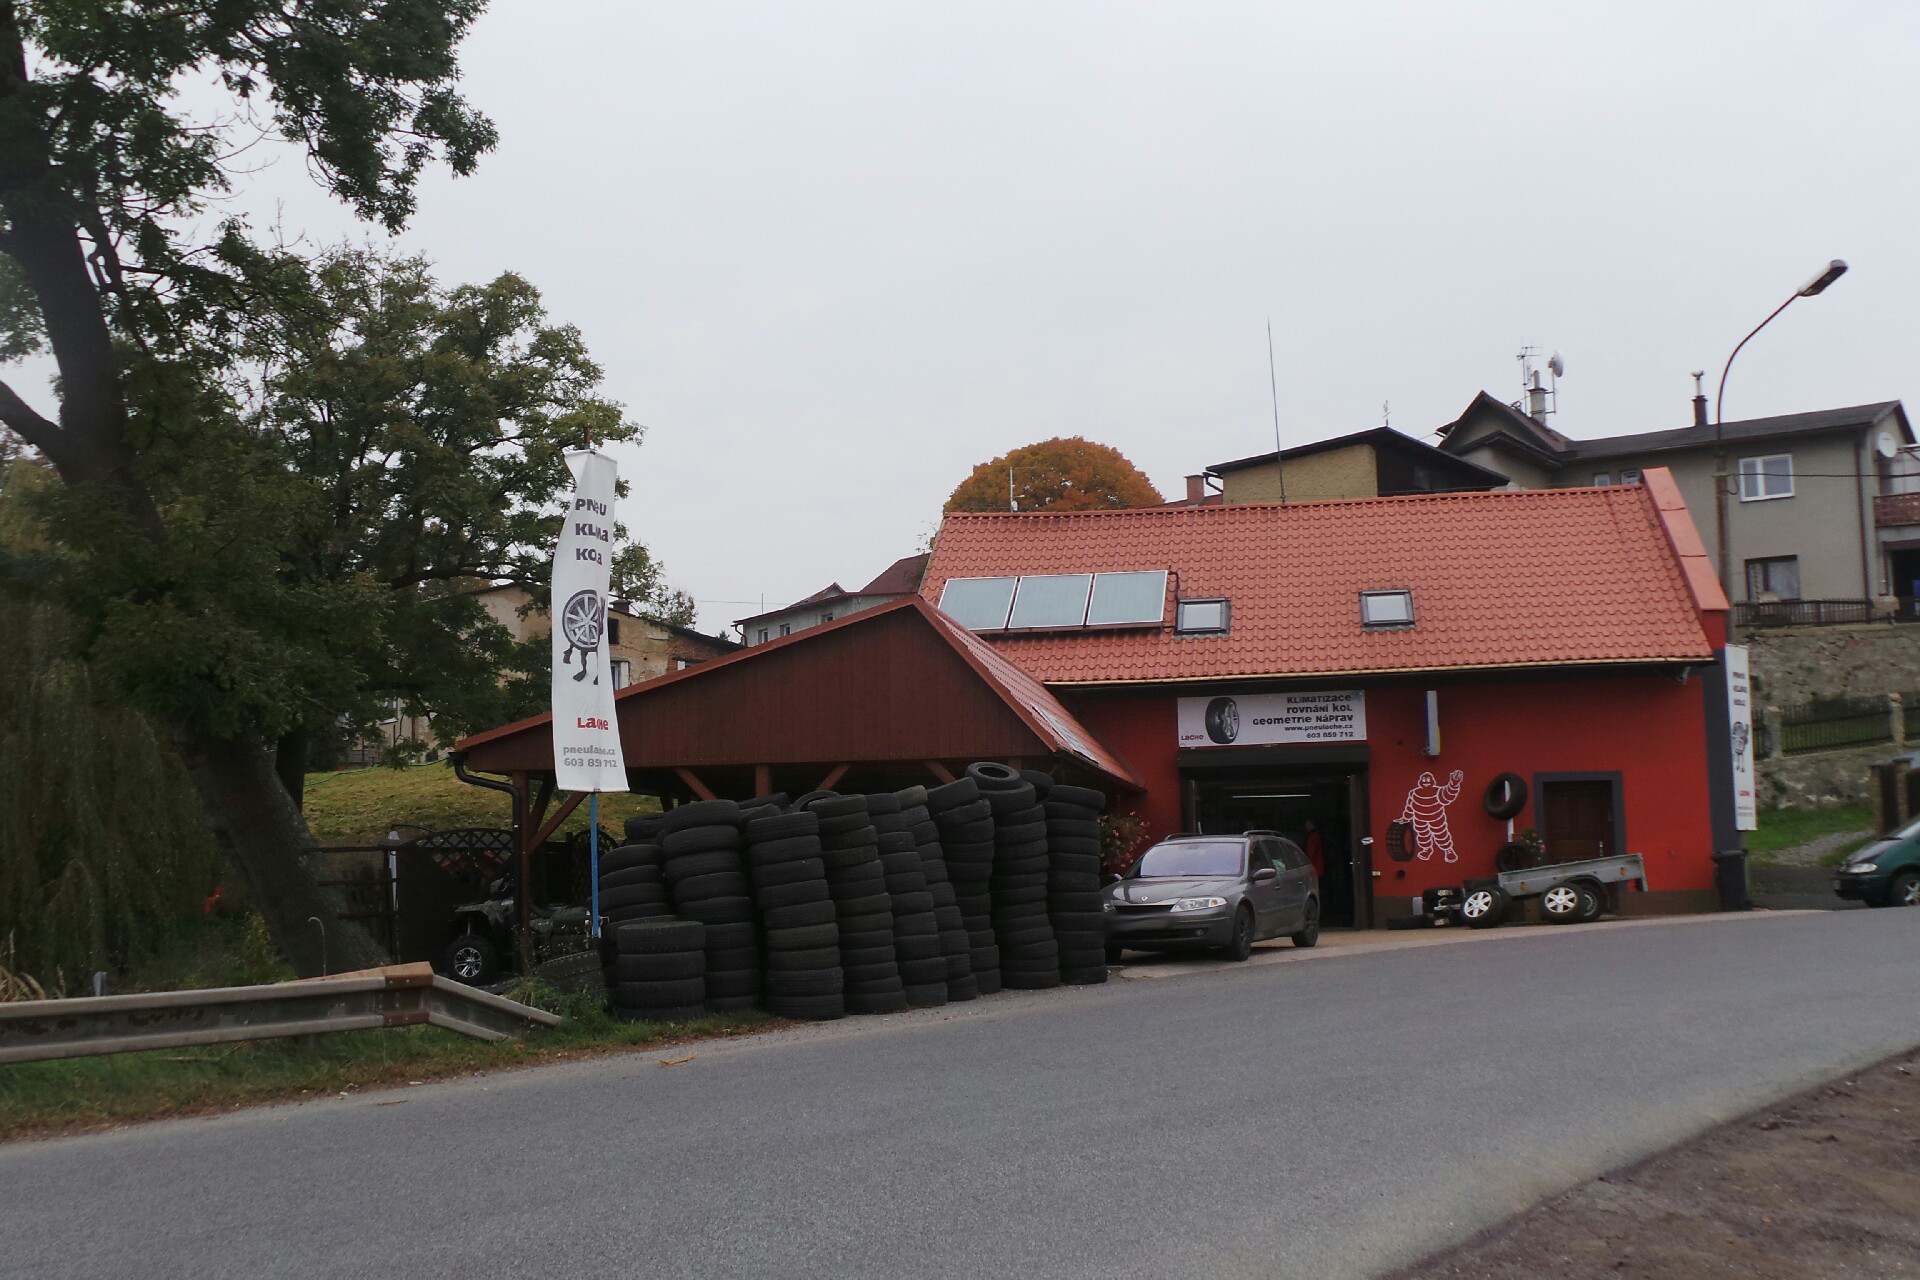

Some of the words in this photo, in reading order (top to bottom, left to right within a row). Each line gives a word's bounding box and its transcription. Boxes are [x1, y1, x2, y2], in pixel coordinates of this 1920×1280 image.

[1284, 724, 1353, 732] www.pneulache.cz
[564, 758, 584, 767] 603
[603, 759, 618, 768] 712
